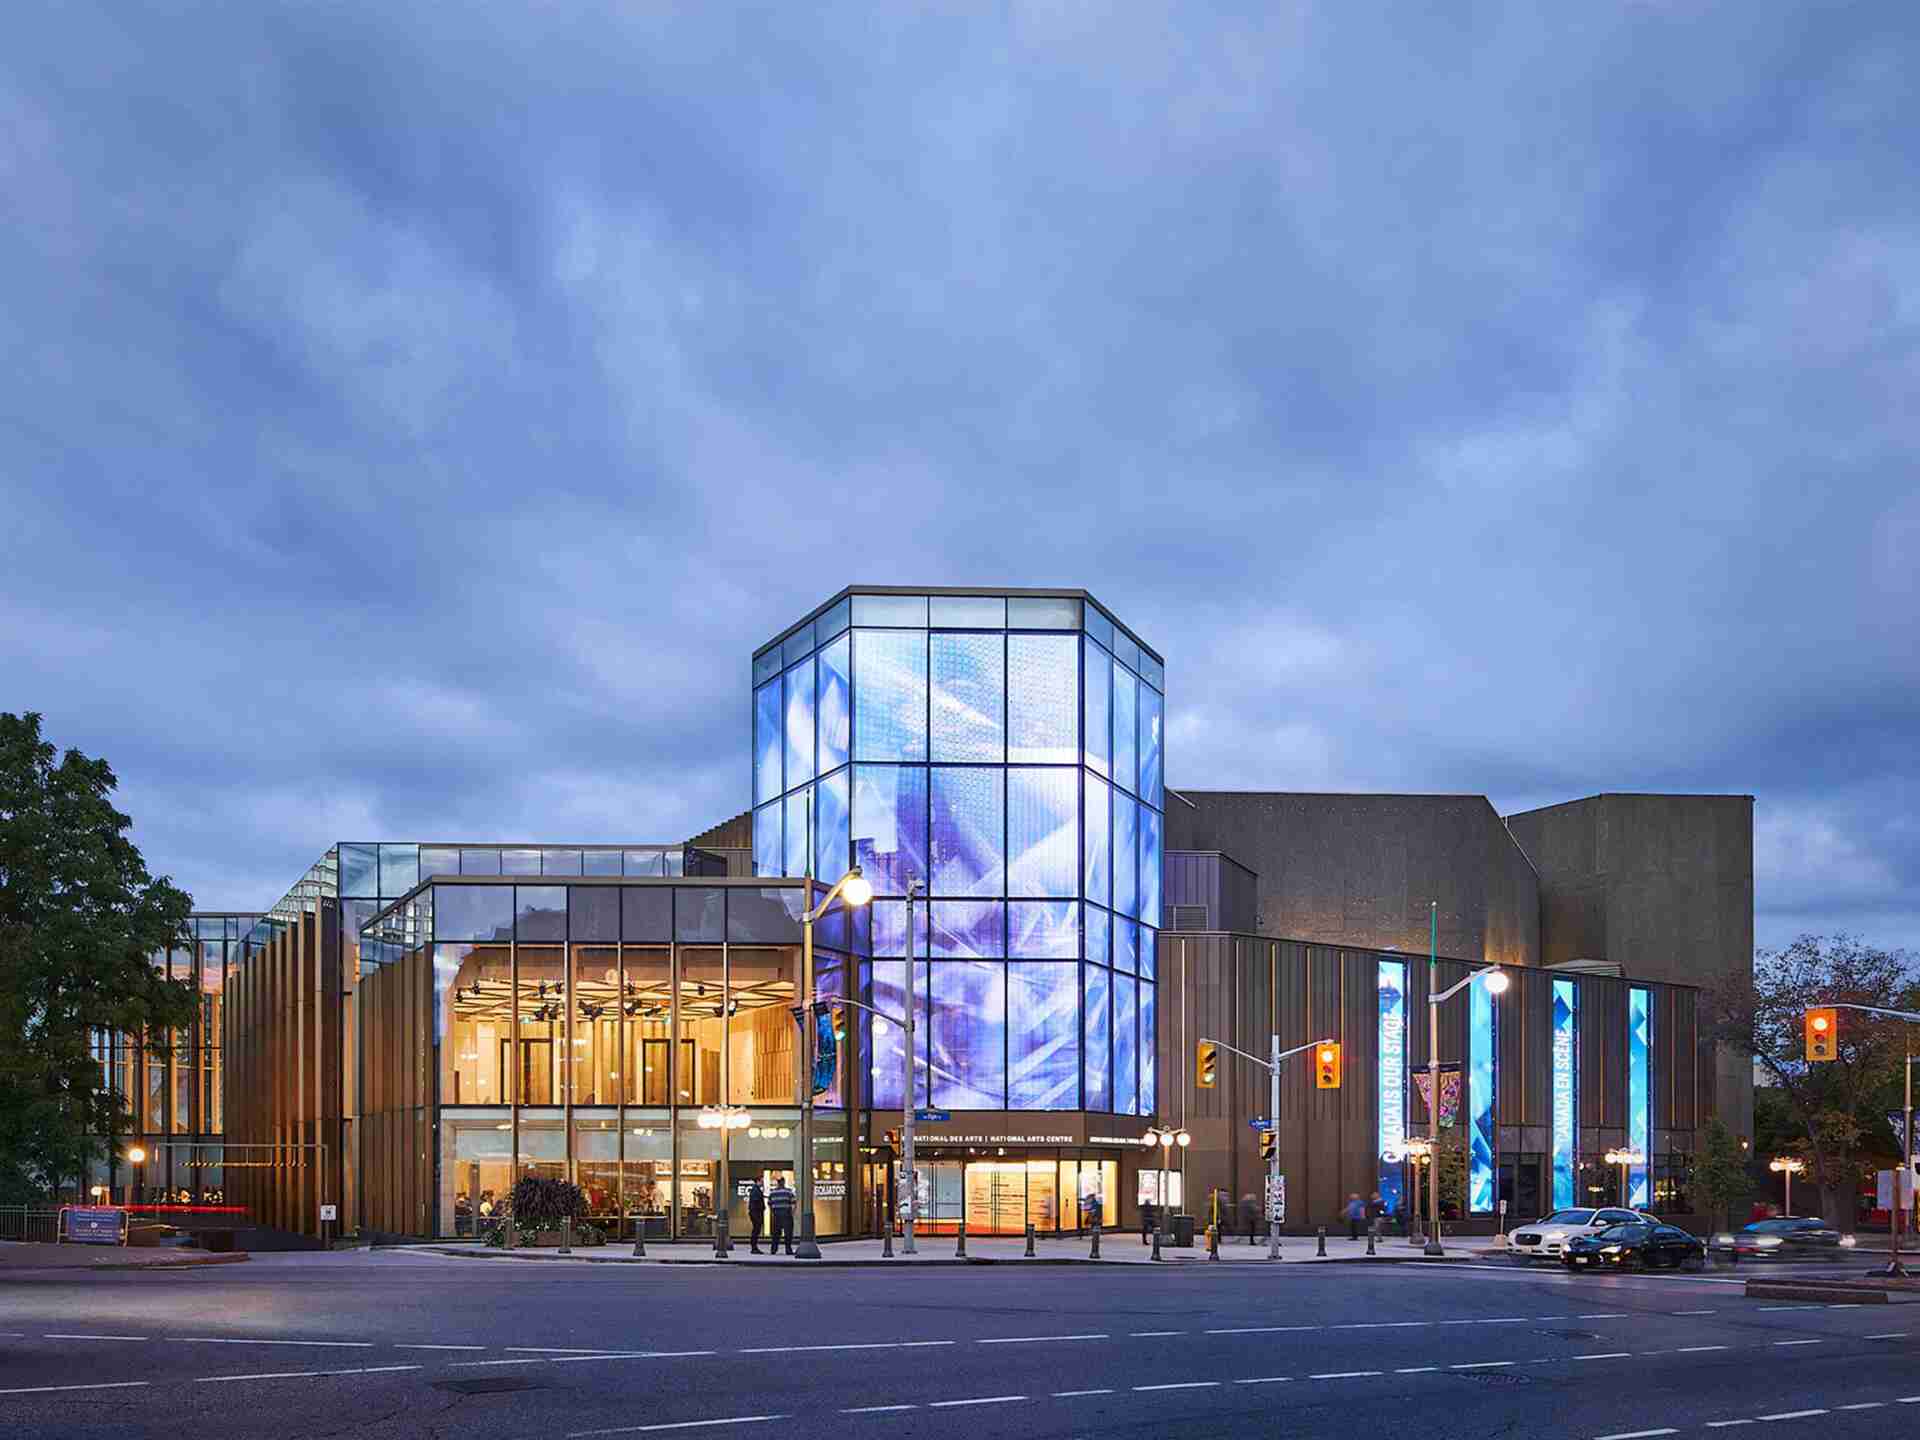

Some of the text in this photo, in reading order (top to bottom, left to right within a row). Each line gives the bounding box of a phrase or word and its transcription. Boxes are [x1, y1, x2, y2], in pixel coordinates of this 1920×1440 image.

[1383, 1012, 1402, 1055] STAGE
[1383, 1057, 1402, 1087] OUR
[1555, 1072, 1569, 1089] EN
[1383, 1090, 1402, 1104] IS
[949, 1135, 963, 1143] DES
[965, 1135, 983, 1143] ARTS
[990, 1135, 1025, 1143] NATIONAL
[1027, 1135, 1045, 1143] ARTS
[1046, 1135, 1073, 1143] CENTRE
[814, 1185, 846, 1195] EQUATOR
